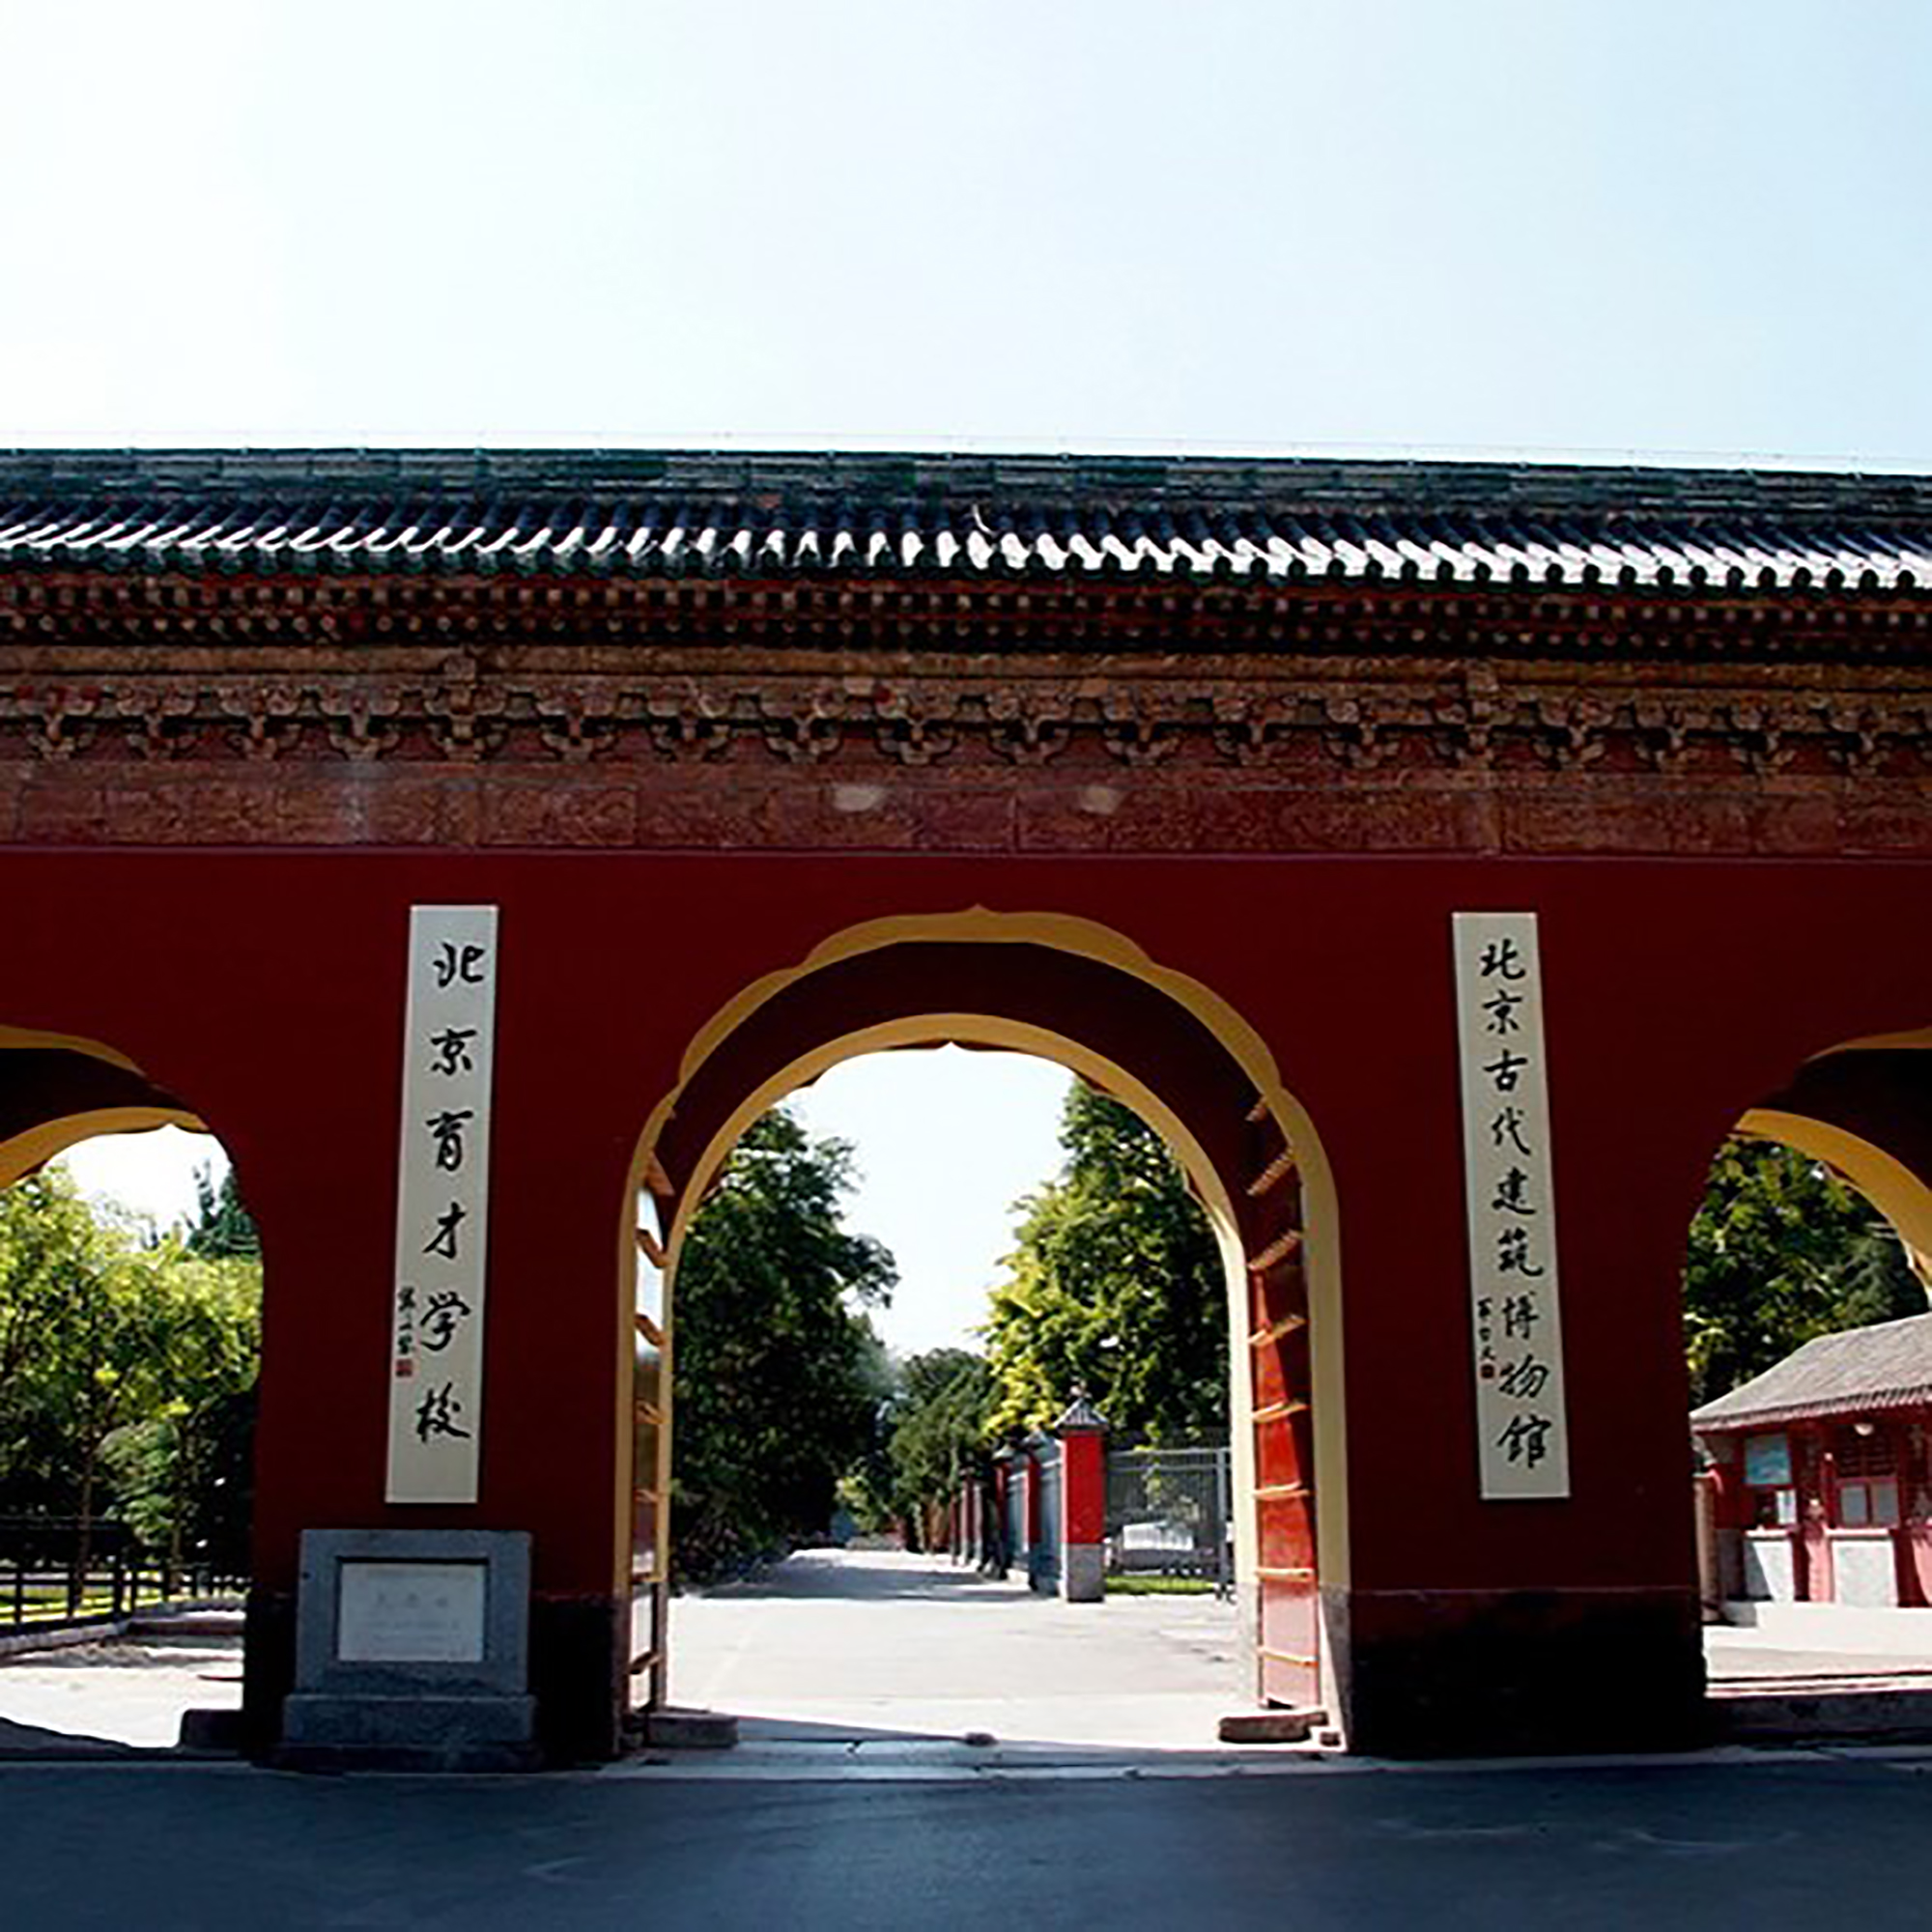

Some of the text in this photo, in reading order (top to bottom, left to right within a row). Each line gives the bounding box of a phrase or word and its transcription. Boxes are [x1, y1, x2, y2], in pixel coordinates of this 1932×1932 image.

[415, 941, 486, 1443] 北京育才学校
[1479, 938, 1552, 1469] 北京古代建筑博物馆
